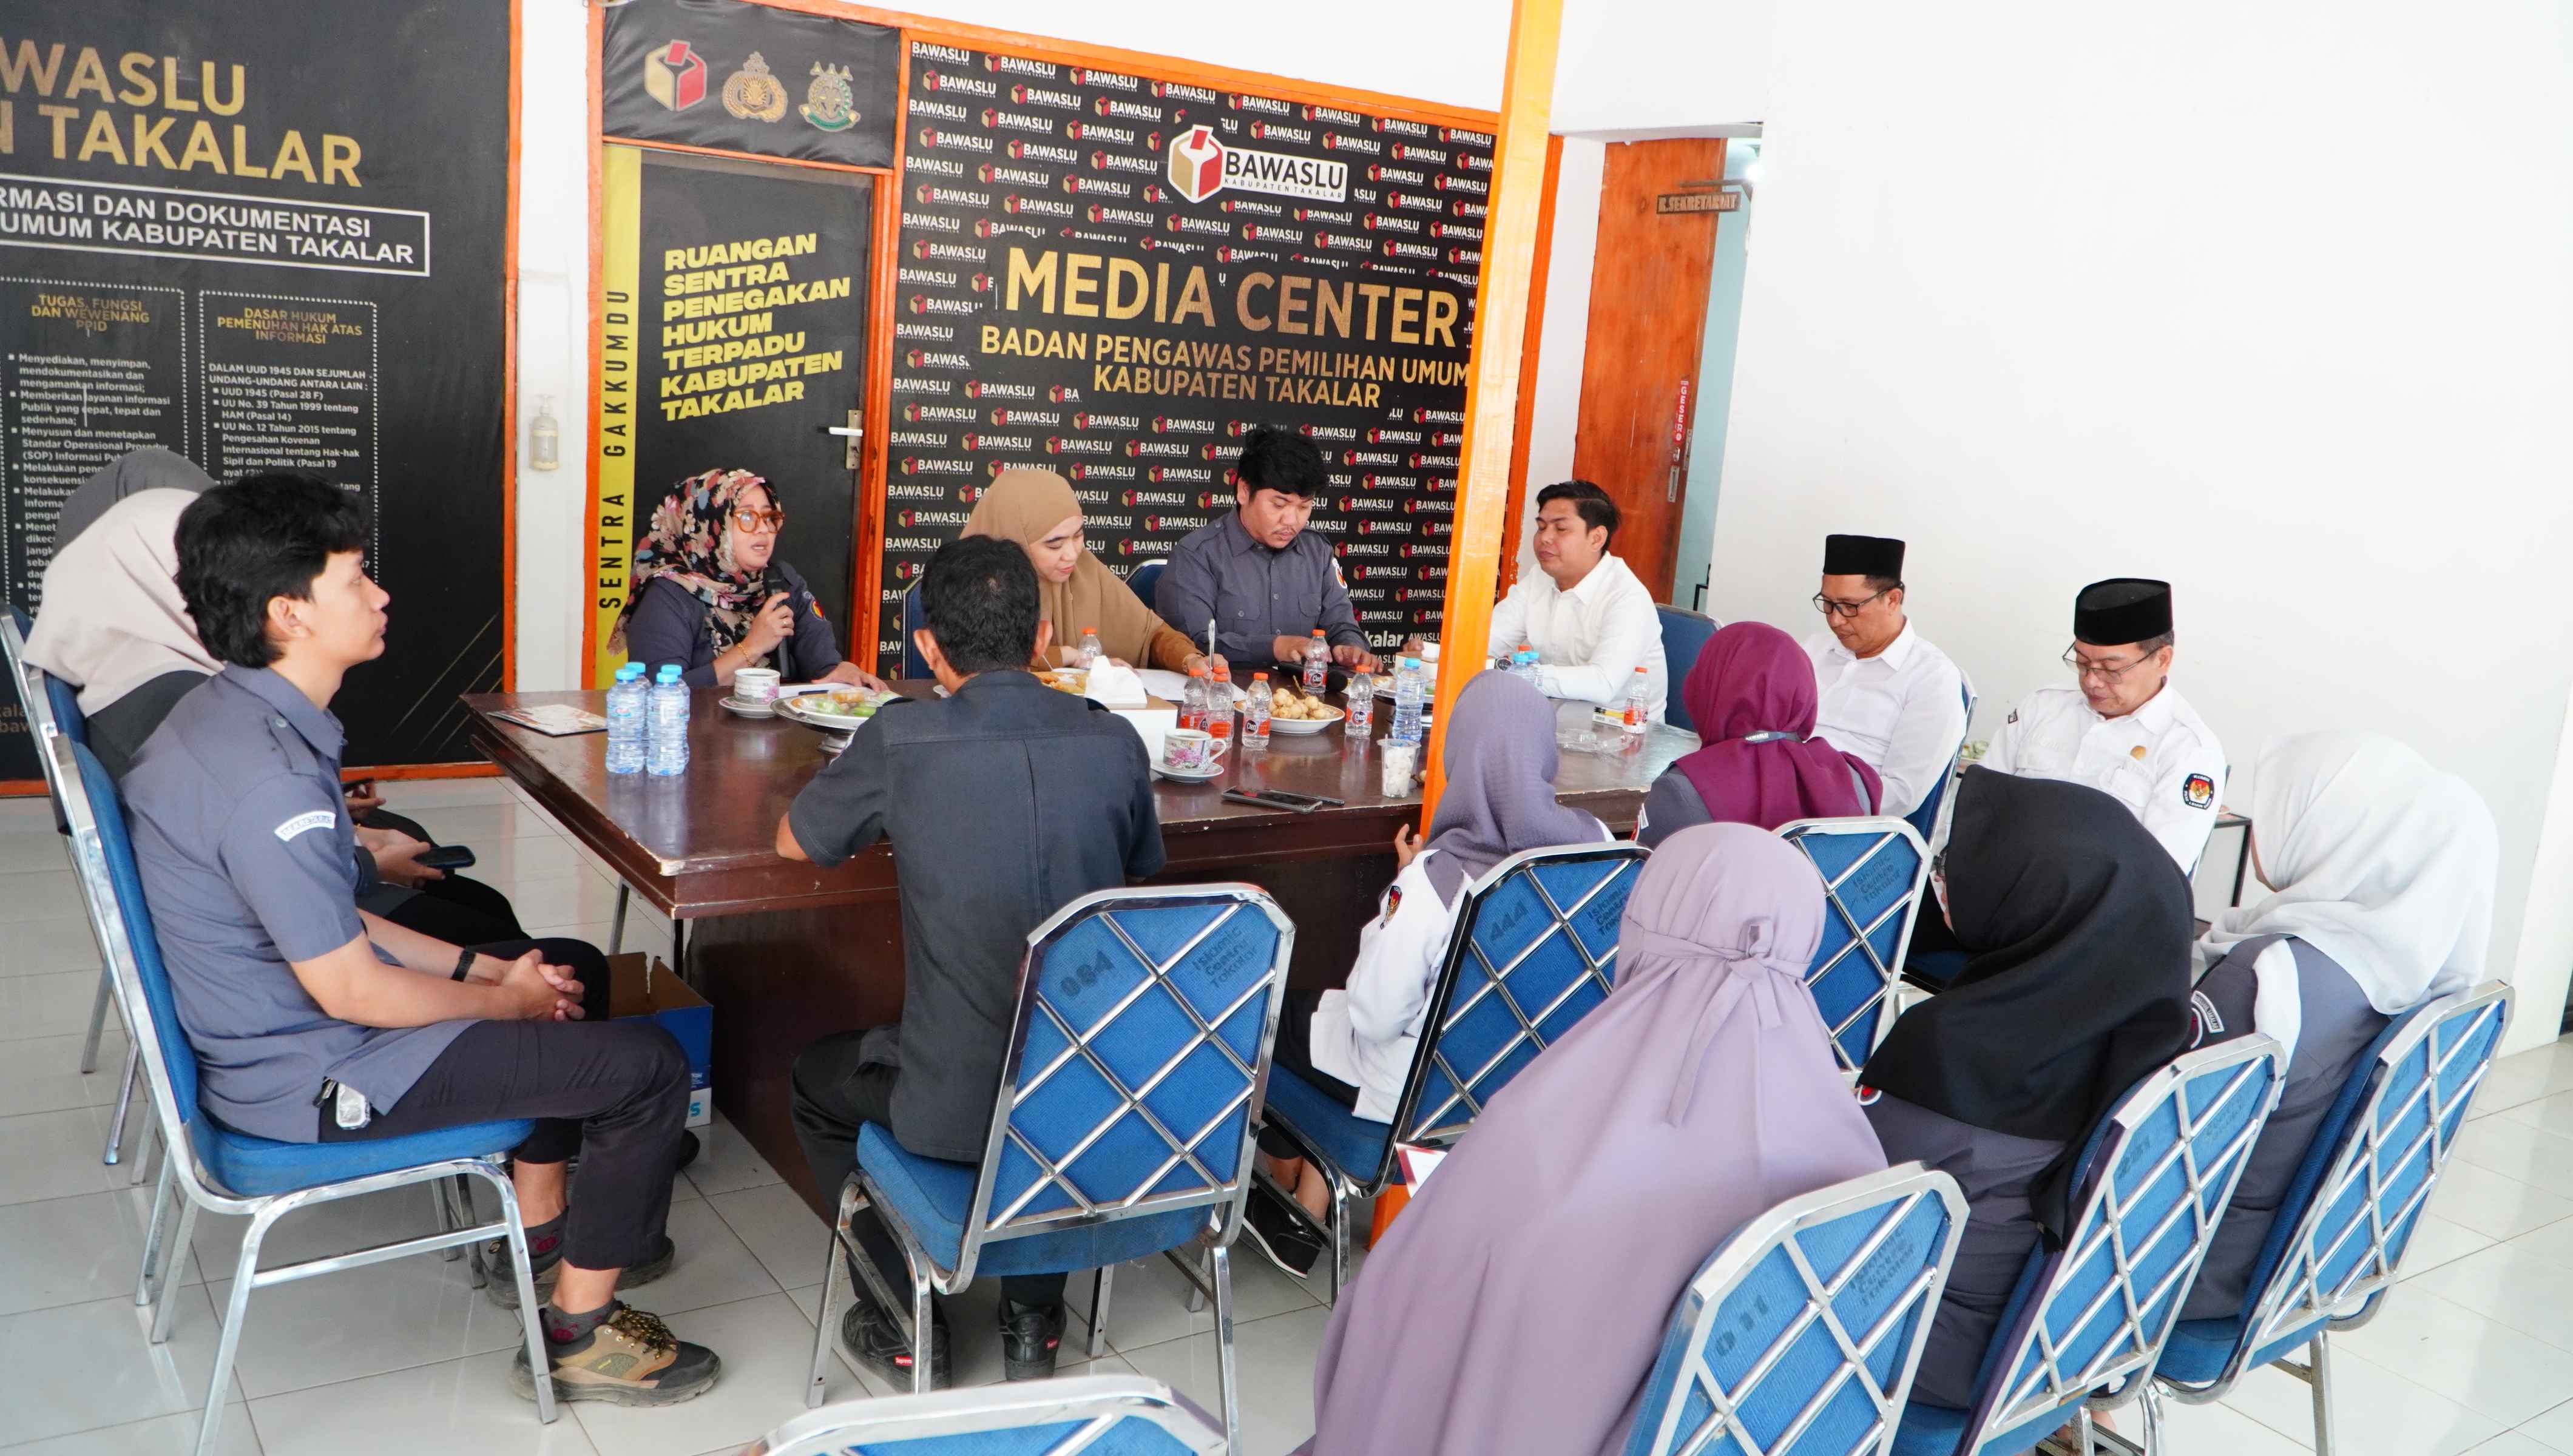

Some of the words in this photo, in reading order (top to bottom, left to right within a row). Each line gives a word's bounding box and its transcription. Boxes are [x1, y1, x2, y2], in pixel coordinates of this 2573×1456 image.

[912, 42, 969, 62] BAWASLU
[1001, 57, 1055, 76] BAWASLU
[939, 75, 996, 94] BAWASLU
[1110, 101, 1161, 119] BAWASLU
[1243, 96, 1290, 113] BAWASLU
[998, 112, 1052, 130] BAWASLU
[1316, 107, 1360, 123] BAWASLU
[1265, 125, 1311, 141] BAWASLU
[1451, 130, 1491, 144] BAWASLU
[38, 104, 362, 187] TAKALAR
[936, 132, 993, 150] BAWASLU
[1404, 146, 1446, 161] BAWASLU
[906, 156, 963, 174] BAWASLU
[1107, 155, 1157, 172] BAWASLU
[1225, 151, 1344, 189] BAWASLU
[1381, 167, 1423, 183] BAWASLU
[1078, 178, 1130, 194] BAWASLU
[1020, 198, 1073, 215] BAWASLU
[1401, 195, 1442, 209] BAWASLU
[94, 195, 155, 219] DAN
[166, 201, 370, 238] DOKUMENTASI
[903, 212, 960, 229] BAWASLU
[1182, 218, 1229, 232] BAWASLU
[1442, 224, 1483, 238] BAWASLU
[1, 212, 92, 239] UMUM
[103, 220, 277, 253] KABUPATEN
[286, 235, 414, 264] TAKALAR
[1257, 226, 1302, 241] BAWASLU
[665, 233, 817, 271] RUANGAN
[930, 243, 986, 260] BAWASLU
[664, 261, 789, 297] SENTRA
[92, 298, 142, 311] FUNGSI
[663, 277, 850, 322] PENEGAKAN
[1006, 247, 1215, 328] MEDIA
[1236, 272, 1459, 348] CENTER
[32, 306, 61, 317] DAN
[65, 308, 150, 323] WEWENANG
[244, 308, 287, 320] DASAR
[291, 311, 336, 323] HUKUM
[76, 320, 107, 332] PPID
[217, 317, 299, 331] PEMENUHAN
[303, 323, 328, 334] HAK
[332, 325, 362, 335] ATAS
[663, 312, 773, 347] HUKUM
[255, 331, 326, 345] INFORMASI
[663, 331, 805, 371] TERPADU
[981, 325, 1087, 360] BADAN
[1095, 334, 1252, 371] PENGAWAS
[1259, 347, 1395, 382] PEMILIHAN
[1402, 359, 1470, 387] UMUM
[19, 353, 88, 366] Menyediakan,
[90, 358, 150, 369] menyimpan,
[19, 367, 123, 379] mendokumentasikan
[126, 371, 144, 379] dan
[209, 363, 244, 374] DALAM
[246, 365, 267, 374] UUD
[269, 366, 291, 376] 1945
[294, 368, 314, 377] DAN
[317, 369, 365, 379] SEJUMLAH
[603, 291, 629, 457] GAKKUMDU
[661, 350, 842, 397] KABUPATEN
[20, 379, 93, 390] mengamankan
[96, 382, 145, 393] informasi;
[209, 375, 297, 387] UNDANG-UNDANG
[300, 379, 338, 389] ANTARA
[341, 381, 363, 390] LAIN
[894, 379, 950, 391] BAWASLU
[1094, 365, 1257, 400] KABUPATEN
[1265, 376, 1381, 408] TAKALAR
[20, 391, 83, 402] Memberikan
[125, 394, 170, 405] informasi
[221, 387, 242, 396] UUD
[245, 388, 267, 398] 1945
[269, 389, 297, 400] (Pasal
[300, 391, 311, 400] 28
[314, 391, 323, 400] F)
[660, 380, 804, 421] TAKALAR
[21, 403, 52, 413] Publik
[55, 406, 79, 415] yang
[115, 407, 140, 417] tepat
[143, 408, 161, 416] dan
[222, 399, 235, 408] UU
[238, 400, 253, 409] No.
[257, 400, 268, 409] 39
[271, 401, 298, 410] Tahun
[300, 402, 322, 411] 1999
[323, 403, 359, 414] tentang
[921, 406, 976, 419] BAWASLU
[21, 415, 76, 426] sederhana;
[222, 411, 244, 420] HAM
[246, 411, 274, 422] (Pasal
[277, 413, 291, 423] 14)
[1089, 415, 1138, 427] BAWASLU
[222, 422, 235, 431] UU
[238, 423, 254, 432] No.
[257, 424, 266, 433] 12
[269, 425, 296, 433] Tahun
[298, 425, 320, 434] 2015
[322, 426, 357, 437] tentang
[1167, 419, 1214, 431] BAWASLU
[22, 427, 72, 438] Menyusun
[75, 429, 93, 437] dan
[95, 430, 156, 441] menetapkan
[223, 434, 279, 445] Pengesahan
[281, 436, 320, 445] Kovenan
[891, 432, 947, 444] BAWASLU
[1380, 431, 1421, 441] BAWASLU
[22, 439, 61, 448] Standar
[64, 440, 123, 450] Operasional
[223, 445, 283, 456] Internasional
[285, 447, 320, 458] tentang
[323, 449, 359, 457] Hak-hak
[1140, 443, 1189, 454] BAWASLU
[22, 451, 53, 461] (SOP)
[55, 451, 102, 462] Informasi
[223, 457, 244, 467] Sipil
[246, 458, 263, 467] dan
[266, 459, 295, 467] Politik
[297, 459, 325, 469] (Pasal
[327, 460, 337, 469] 19
[1356, 453, 1398, 463] BAWASLU
[23, 463, 76, 473] Melakukan
[223, 469, 243, 478] ayat
[1163, 468, 1211, 479] BAWASLU
[888, 485, 944, 496] BAWASLU
[1137, 493, 1185, 502] BAWASLU
[1351, 498, 1394, 509] BAWASLU
[1370, 522, 1412, 532] BAWASLU
[599, 493, 624, 609] SENTRA
[1366, 567, 1408, 577] BAWASLU
[1362, 610, 1403, 621] BAWASLU
